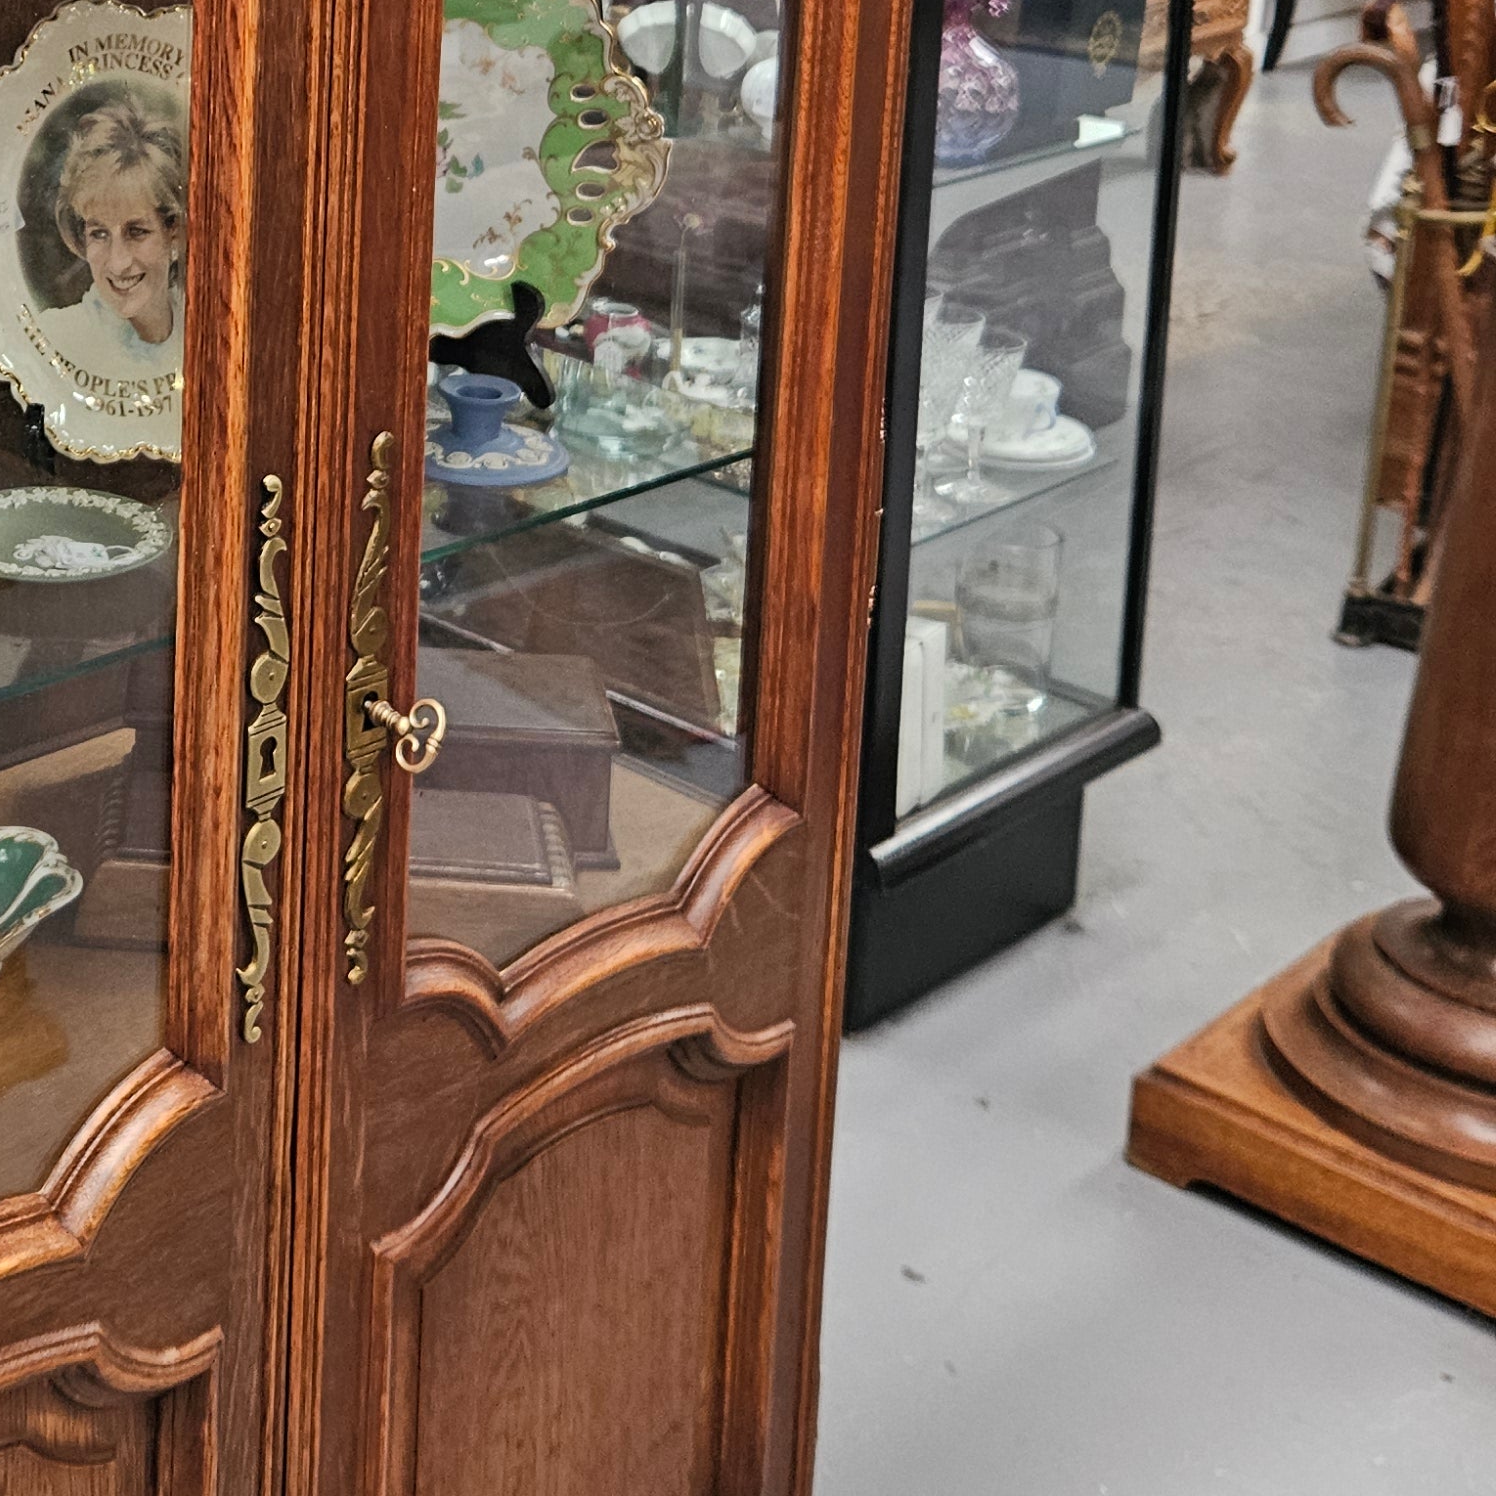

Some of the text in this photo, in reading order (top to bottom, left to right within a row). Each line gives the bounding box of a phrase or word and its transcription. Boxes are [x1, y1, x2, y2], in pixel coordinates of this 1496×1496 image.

[68, 33, 186, 66] IN MEMORY
[77, 53, 173, 81] RINCESS
[85, 394, 171, 417] 961-1997
